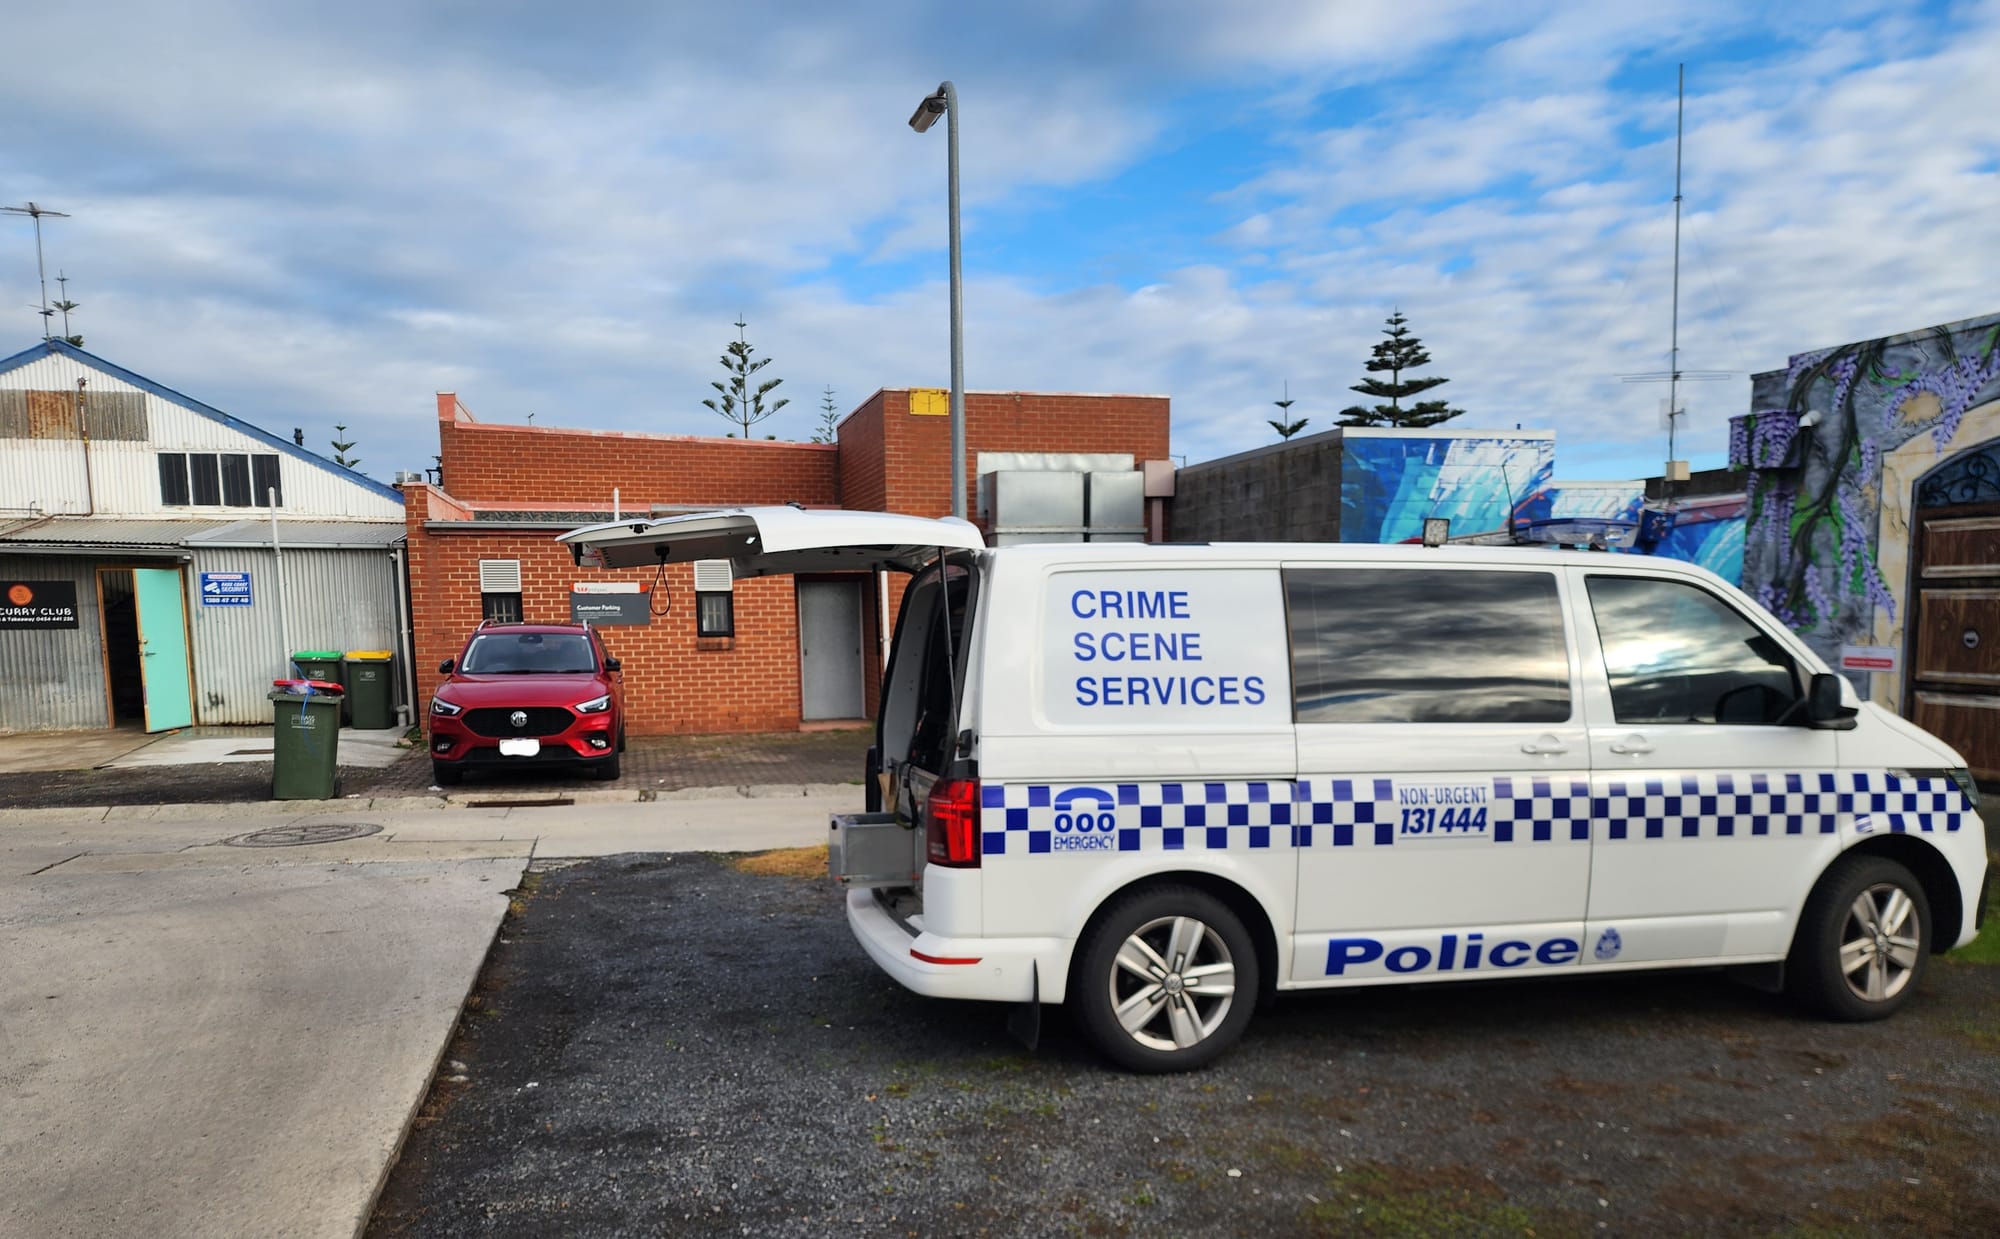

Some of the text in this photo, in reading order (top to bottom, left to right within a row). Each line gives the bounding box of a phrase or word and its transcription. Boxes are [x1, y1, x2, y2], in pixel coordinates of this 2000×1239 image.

[0, 607, 72, 616] CURRY CLUB
[601, 604, 621, 612] Parking
[1071, 590, 1191, 619] CRIME
[1074, 632, 1202, 662] SCENE
[1076, 676, 1265, 706] SERVICES
[1400, 786, 1487, 805] NON-URGENT
[1055, 813, 1115, 833] 000
[1401, 807, 1487, 834] 131 444
[1054, 835, 1115, 850] EMERGENCY
[1325, 933, 1579, 976] Police
